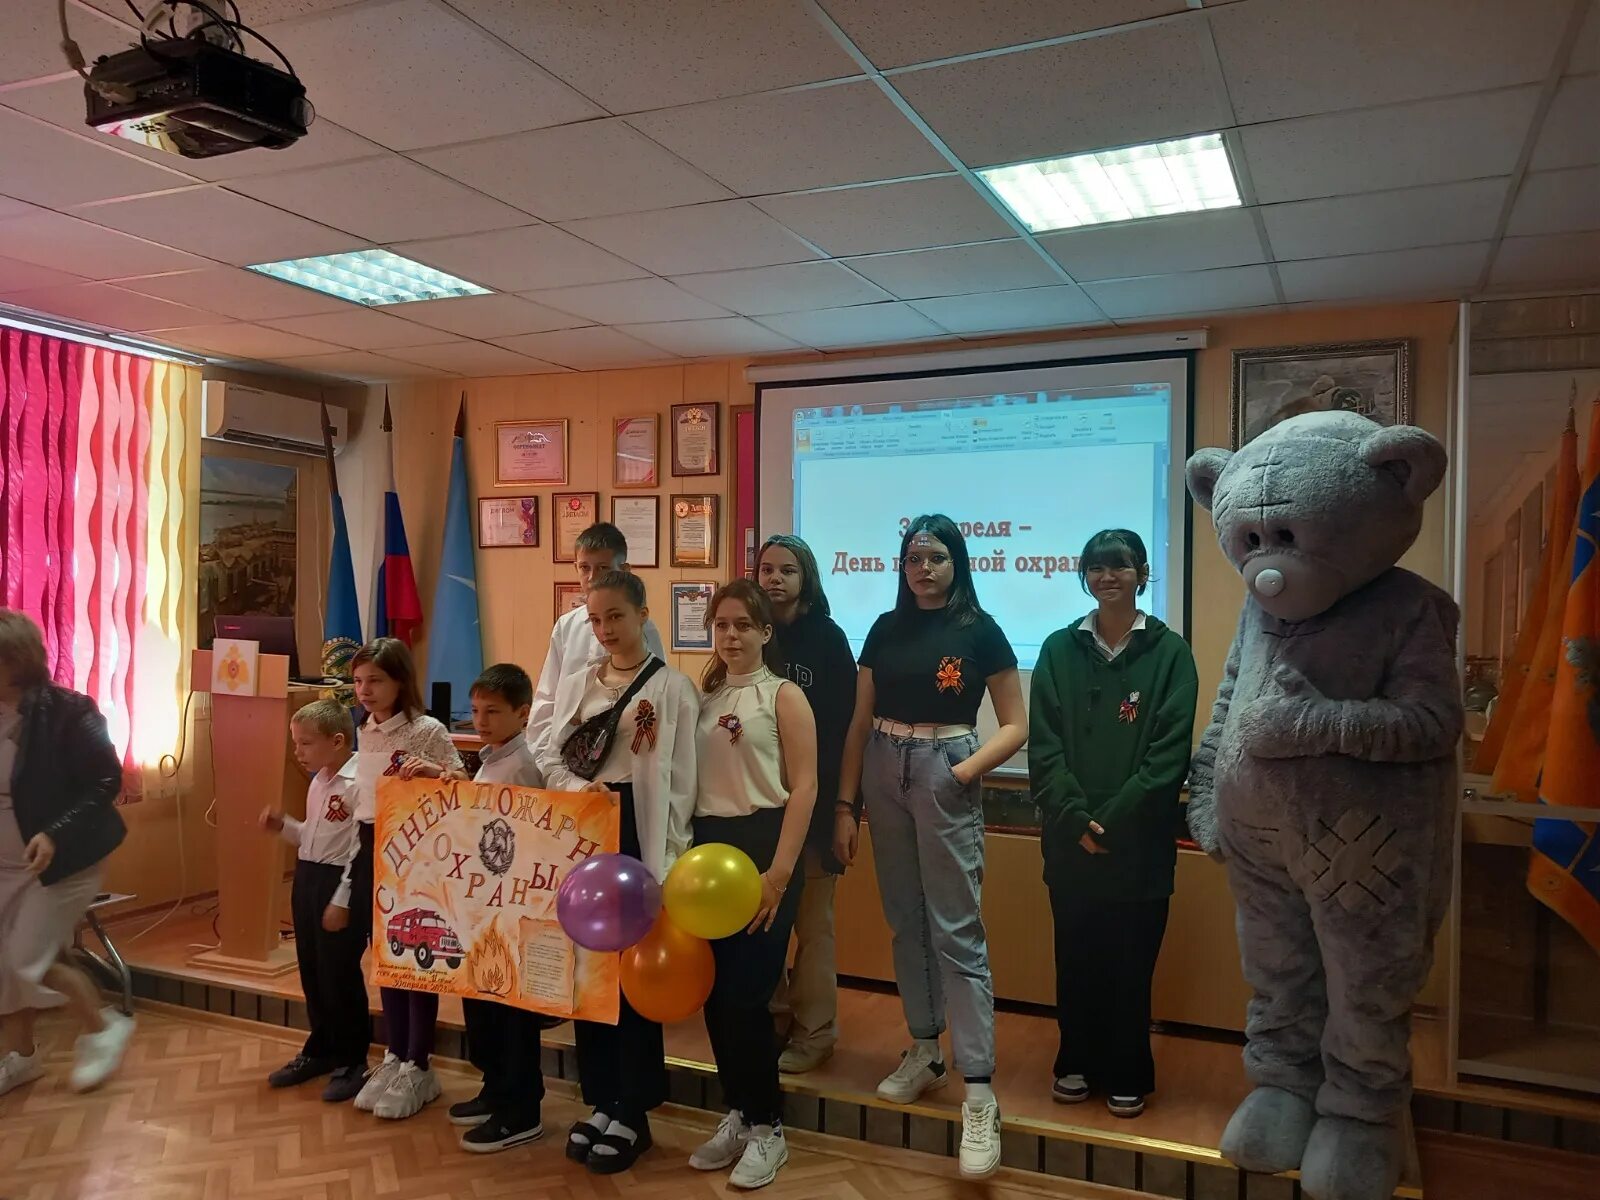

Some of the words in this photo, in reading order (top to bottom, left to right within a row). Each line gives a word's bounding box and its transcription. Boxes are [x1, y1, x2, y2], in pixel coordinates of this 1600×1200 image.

[956, 521, 1012, 538] реля
[832, 551, 885, 576] День
[383, 780, 462, 877] ДНЁМ
[470, 783, 601, 861] ПОЖАРН
[433, 832, 559, 908] ОХРАНЫ
[375, 884, 395, 915] С
